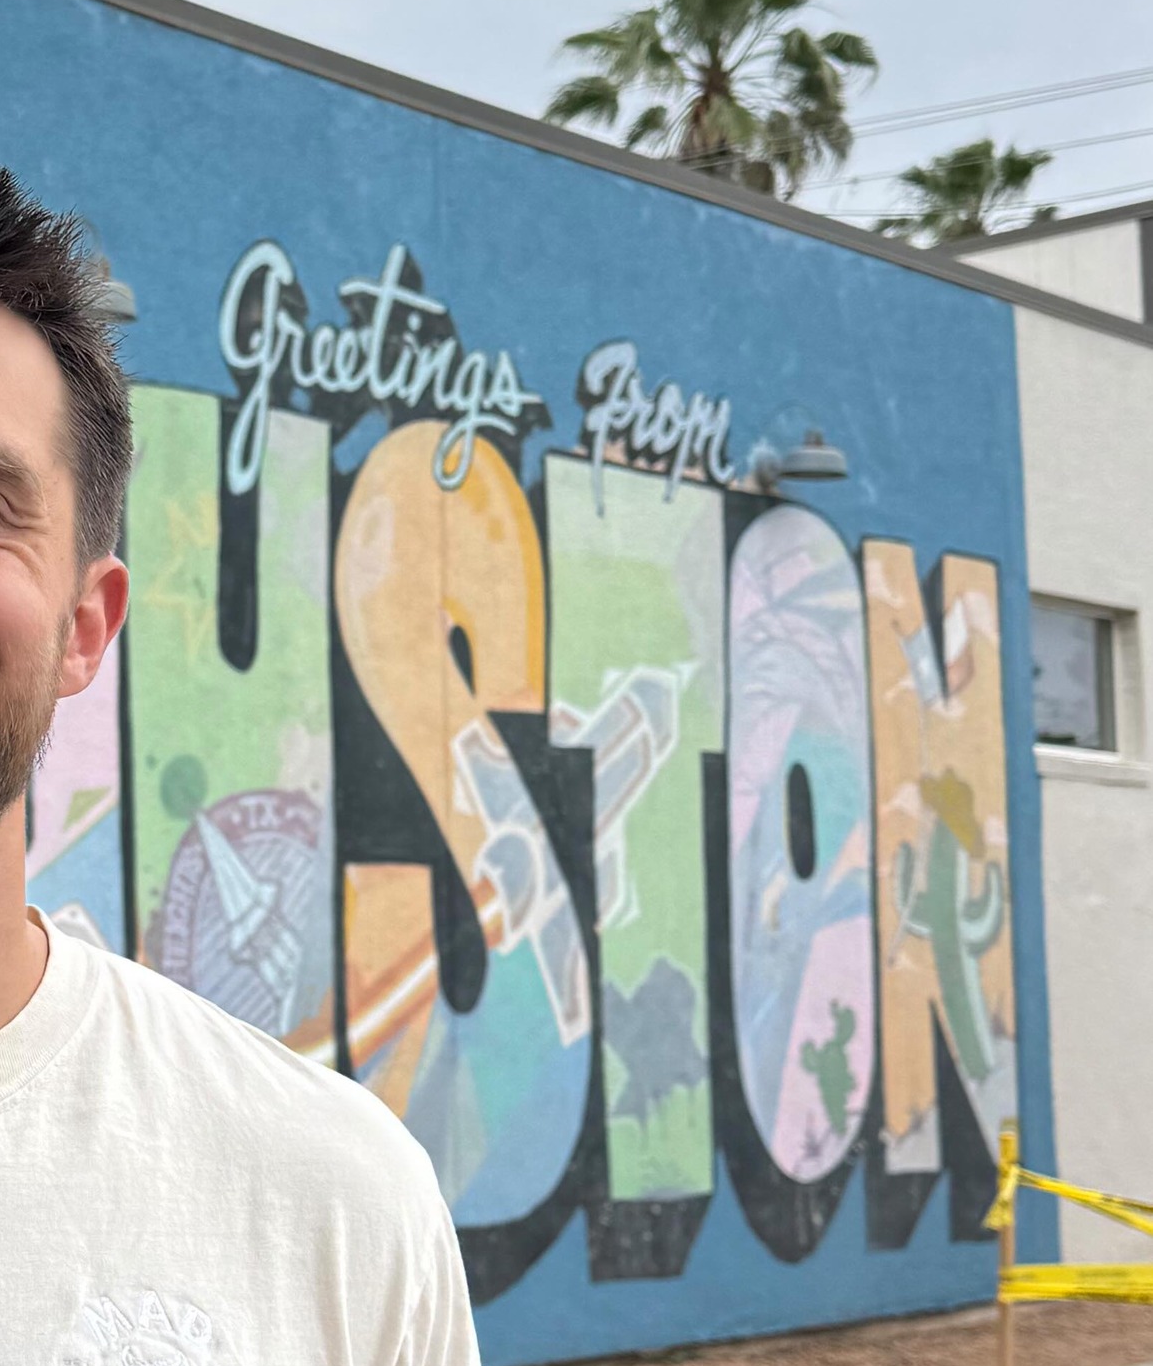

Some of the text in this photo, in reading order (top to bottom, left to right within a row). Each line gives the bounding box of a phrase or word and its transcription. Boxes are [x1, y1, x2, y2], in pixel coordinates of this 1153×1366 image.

[219, 240, 735, 518] Greetings From
[82, 1289, 213, 1346] MAD
